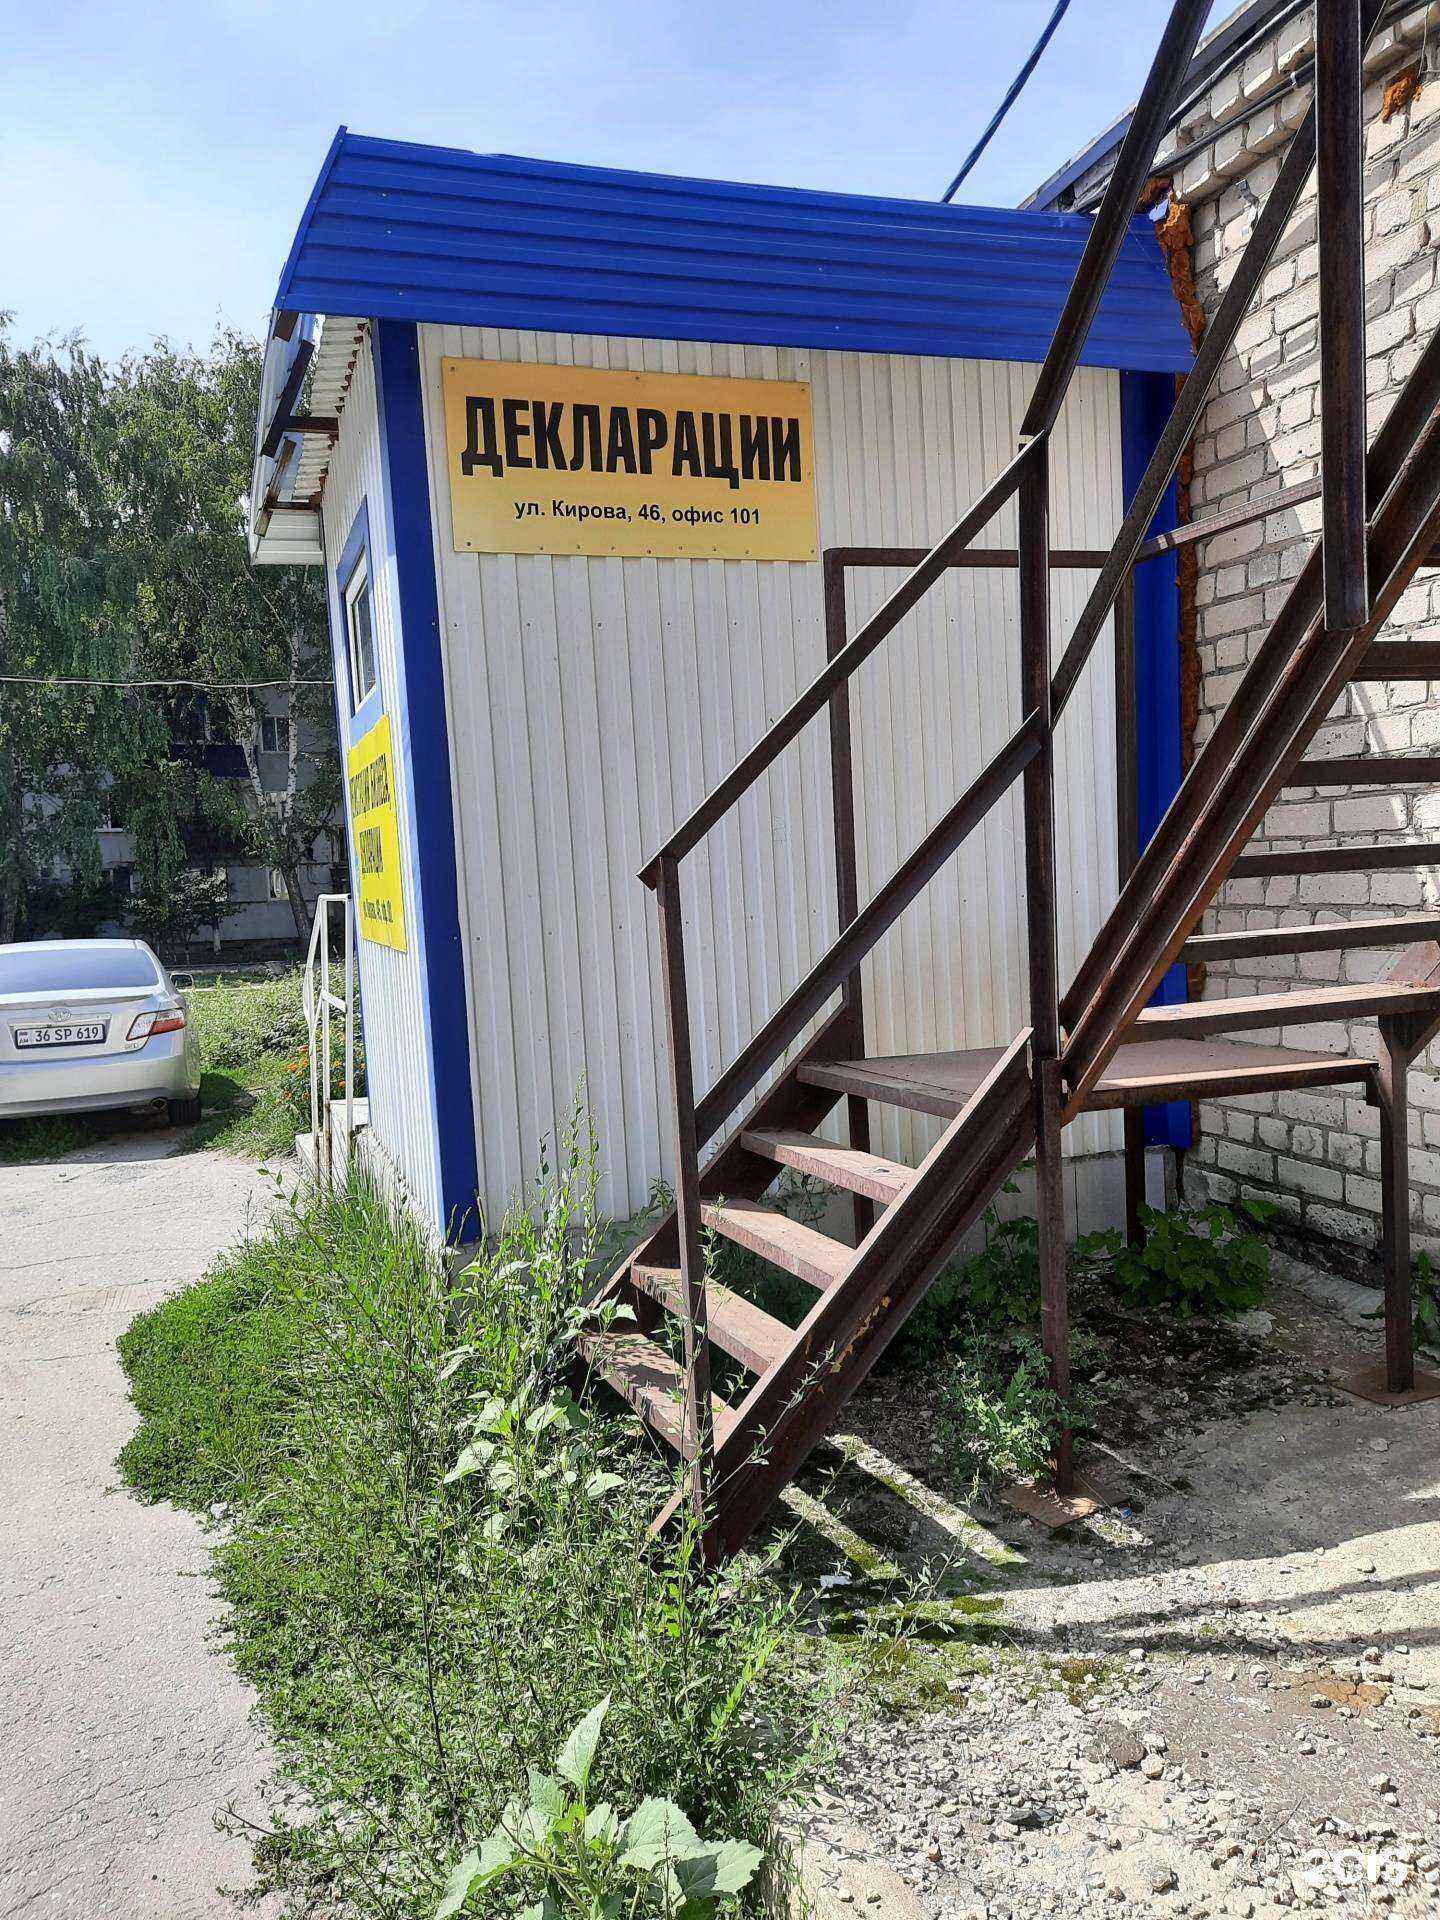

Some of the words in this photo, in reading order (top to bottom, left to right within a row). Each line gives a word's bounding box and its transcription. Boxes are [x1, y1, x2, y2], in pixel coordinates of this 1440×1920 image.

[461, 395, 802, 489] ДЕКЛАРАЦИИ
[515, 501, 545, 519] ул.
[552, 500, 632, 523] Кирова,
[638, 504, 666, 523] 46,
[672, 506, 724, 525] офис
[731, 508, 760, 525] 101
[35, 1030, 51, 1042] 36
[55, 1028, 72, 1041] SP
[76, 1026, 99, 1039] 619
